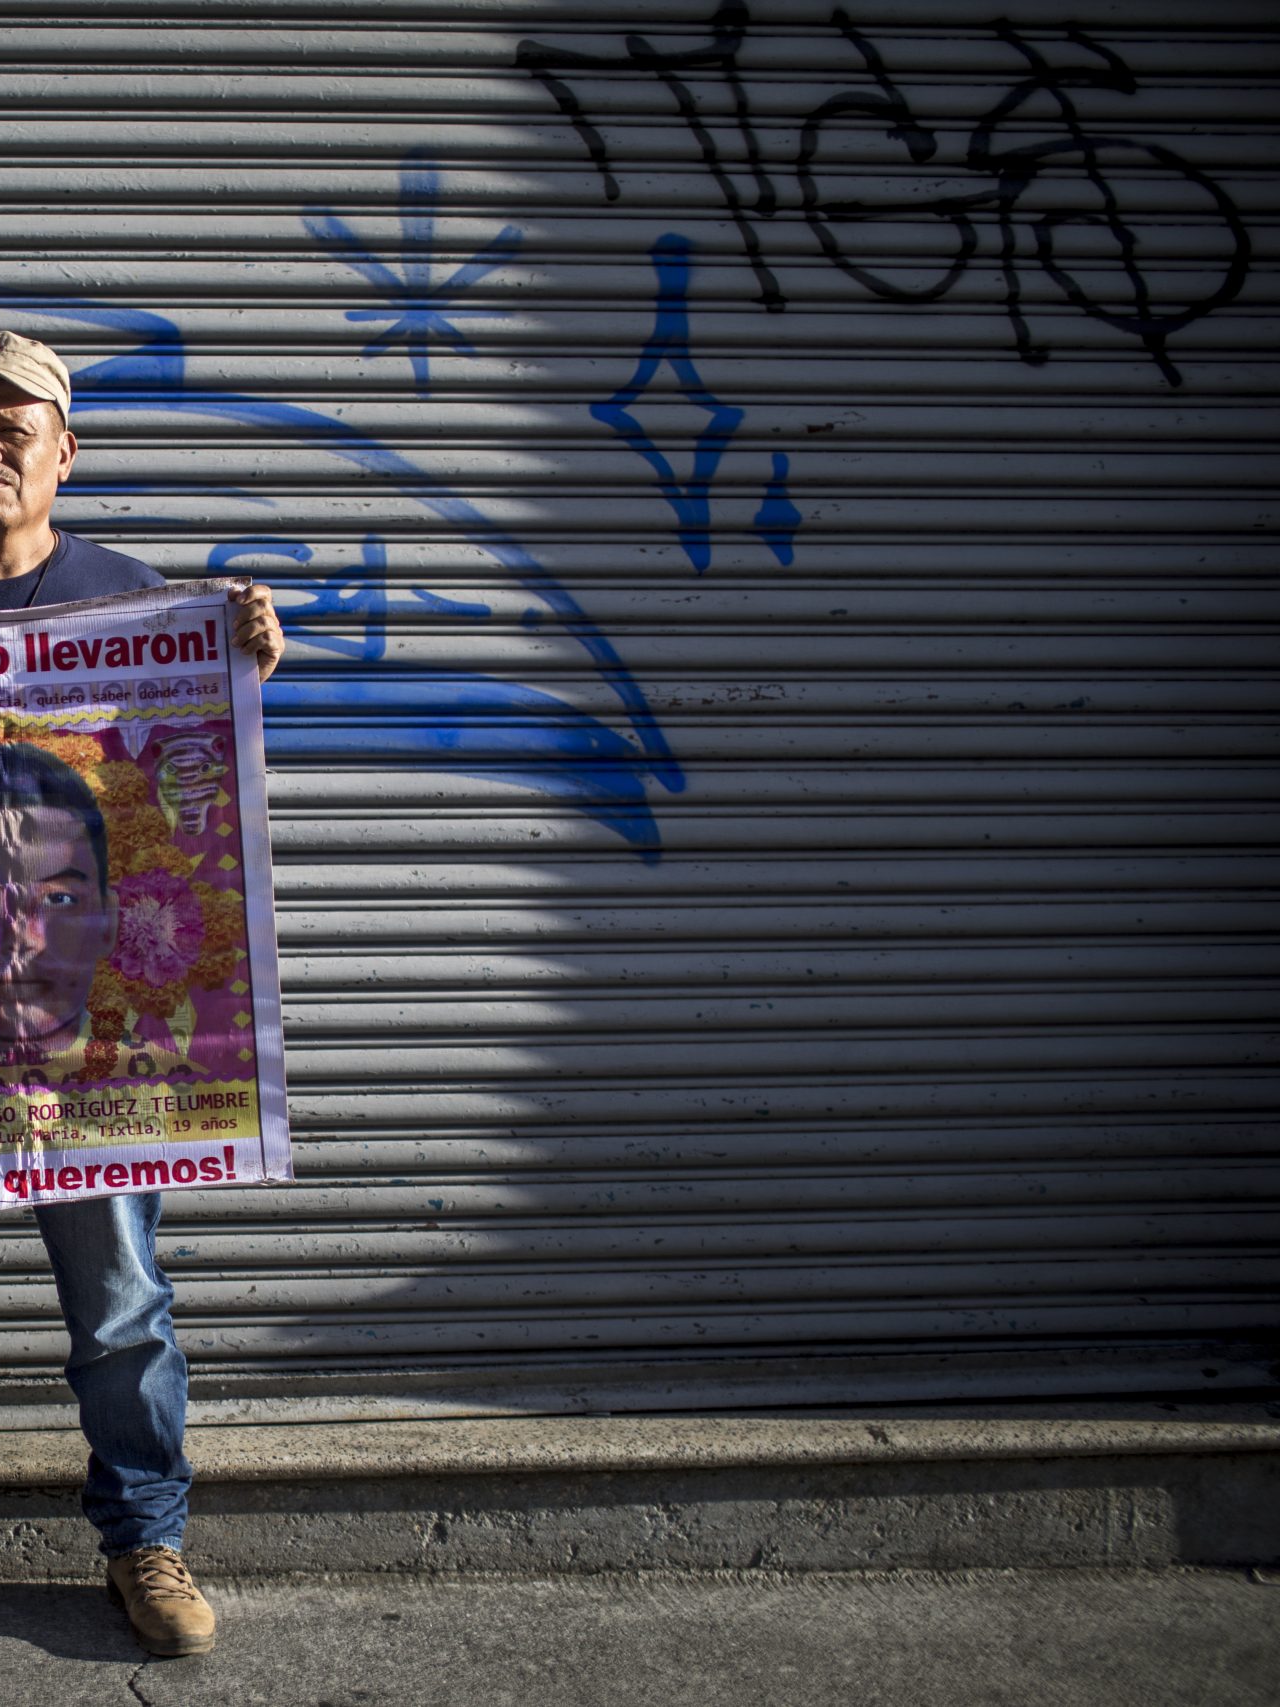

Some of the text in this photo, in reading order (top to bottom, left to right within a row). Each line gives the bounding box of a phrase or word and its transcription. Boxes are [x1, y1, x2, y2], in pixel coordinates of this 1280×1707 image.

[25, 620, 218, 673] llevaron!
[37, 691, 85, 708] quiero
[92, 687, 131, 702] saber
[139, 687, 179, 700] dónde
[186, 683, 218, 696] está
[28, 1098, 138, 1122] RODRÍGUEZ
[151, 1091, 249, 1113] TELUMBRE
[32, 1127, 88, 1142] María,
[98, 1121, 162, 1138] Tixtla,
[173, 1119, 191, 1133] 19
[200, 1117, 237, 1130] años
[4, 1145, 238, 1199] queremos!
